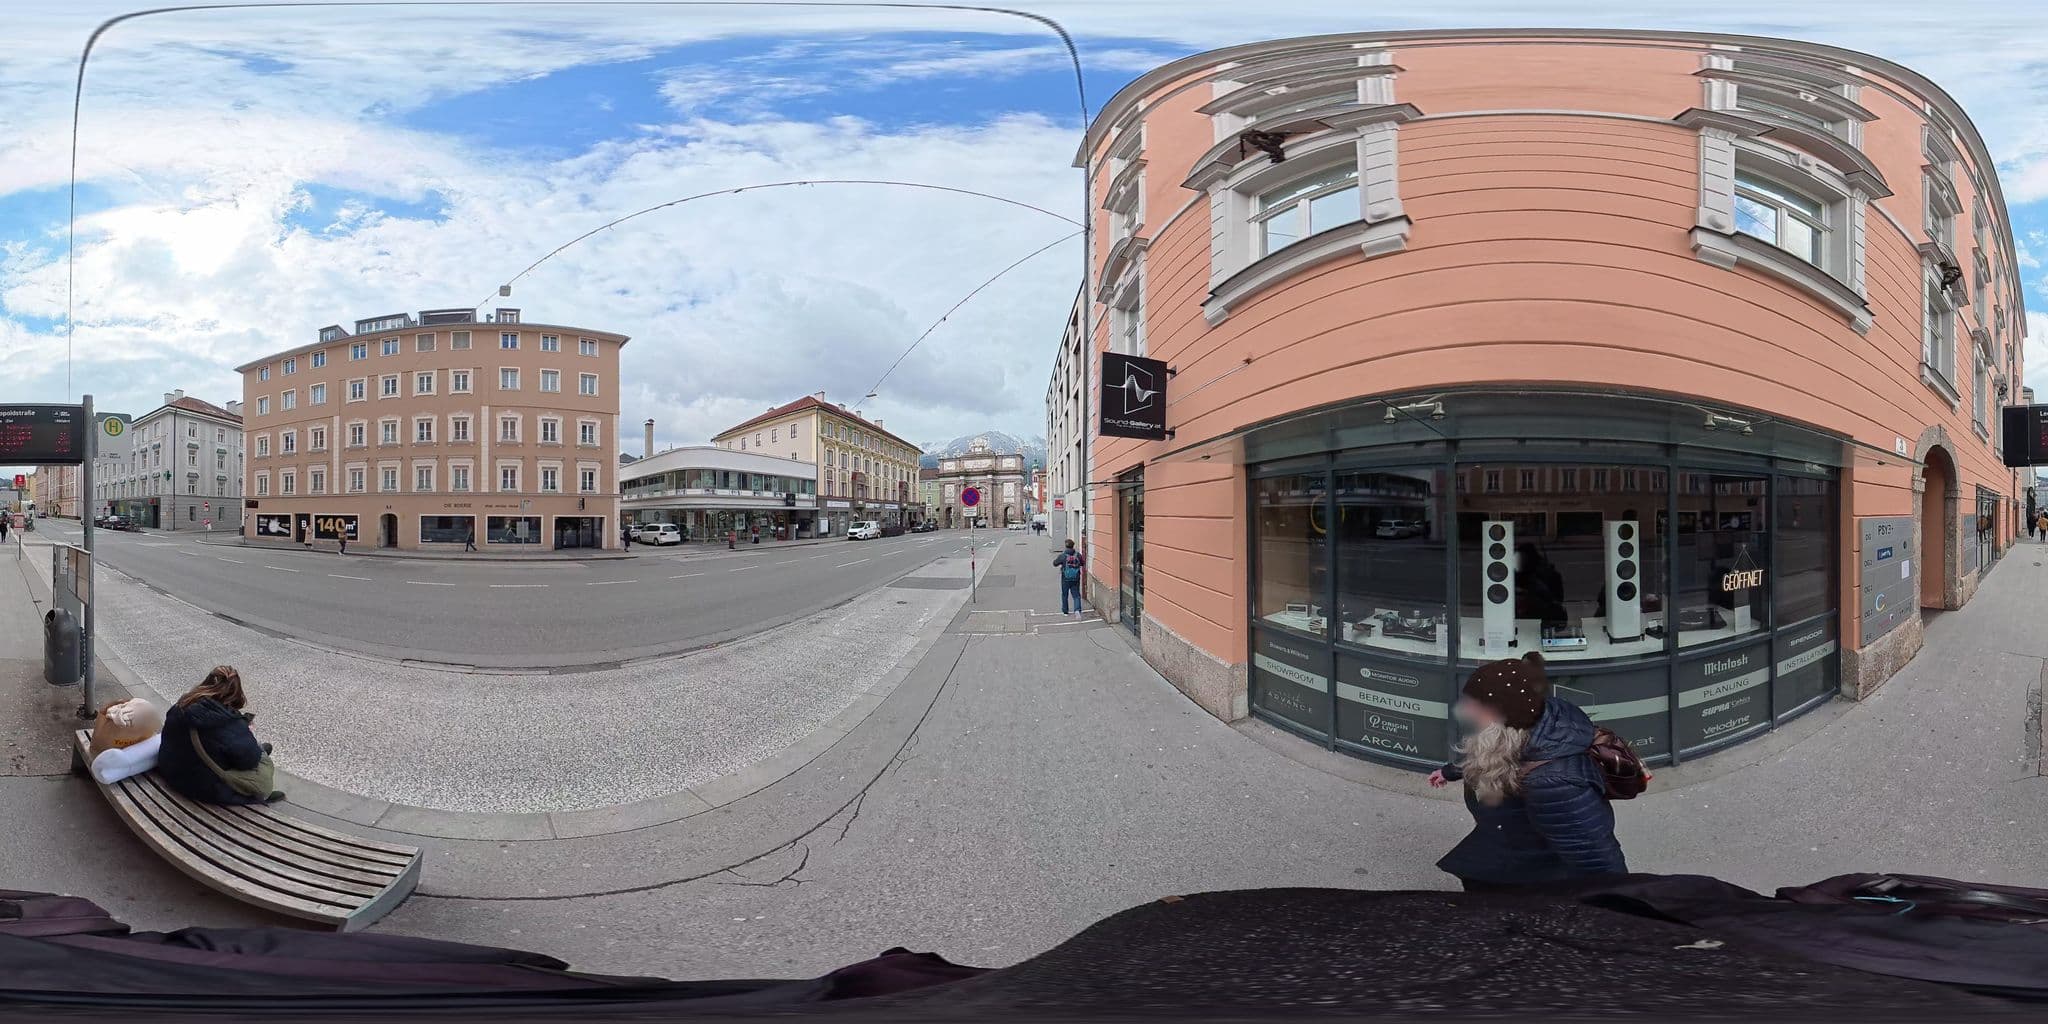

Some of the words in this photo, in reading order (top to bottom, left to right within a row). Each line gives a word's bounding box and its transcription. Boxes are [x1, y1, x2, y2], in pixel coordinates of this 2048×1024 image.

[317, 517, 346, 533] 140
[1722, 568, 1764, 592] GEÖFFNET
[1704, 654, 1748, 676] McIntosh
[1784, 646, 1828, 671] INSTALLATION
[1266, 660, 1314, 686] SHOWROOM
[1397, 675, 1417, 685] AUDIO
[1703, 678, 1750, 698] PLANUNG
[1268, 691, 1312, 713] ADVANCE
[1359, 691, 1422, 711] BERATUNG
[1701, 702, 1730, 717] SUPRA
[1381, 720, 1409, 731] ORIGIN
[1703, 714, 1750, 735] Velodyne
[1361, 734, 1418, 754] ARCAM
